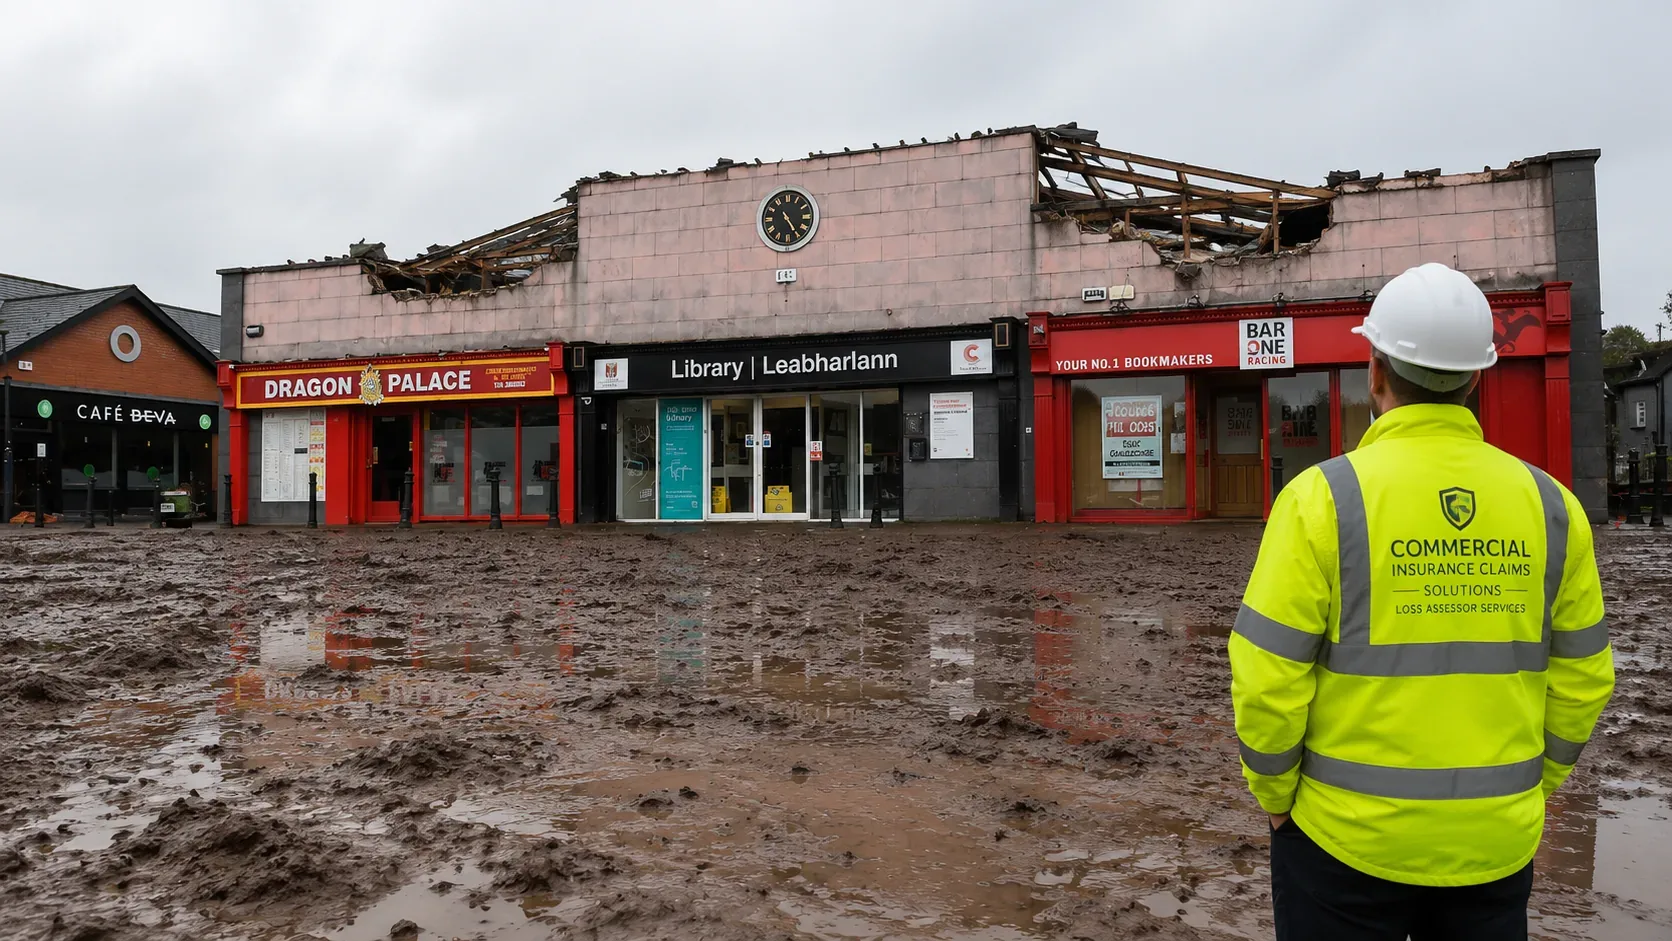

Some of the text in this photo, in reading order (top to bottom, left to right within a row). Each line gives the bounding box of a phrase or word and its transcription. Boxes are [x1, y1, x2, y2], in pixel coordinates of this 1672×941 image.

[1247, 321, 1285, 338] BAR
[1247, 339, 1286, 355] ONE
[671, 359, 744, 381] Library
[763, 351, 898, 375] Leabharlann
[1056, 360, 1088, 371] YOUR
[1124, 354, 1213, 368] BOOKMAKERS
[1248, 356, 1286, 365] RACING
[265, 370, 471, 398] DRAGON PALACE
[77, 404, 123, 422] CAFÉ
[1391, 539, 1531, 557] COMMERCIAL
[1392, 563, 1531, 576] INSURANCE CLAIMS
[1424, 584, 1502, 596] SOLUTIONS
[1396, 603, 1526, 614] LOSS ASSESSOR SERVICES
